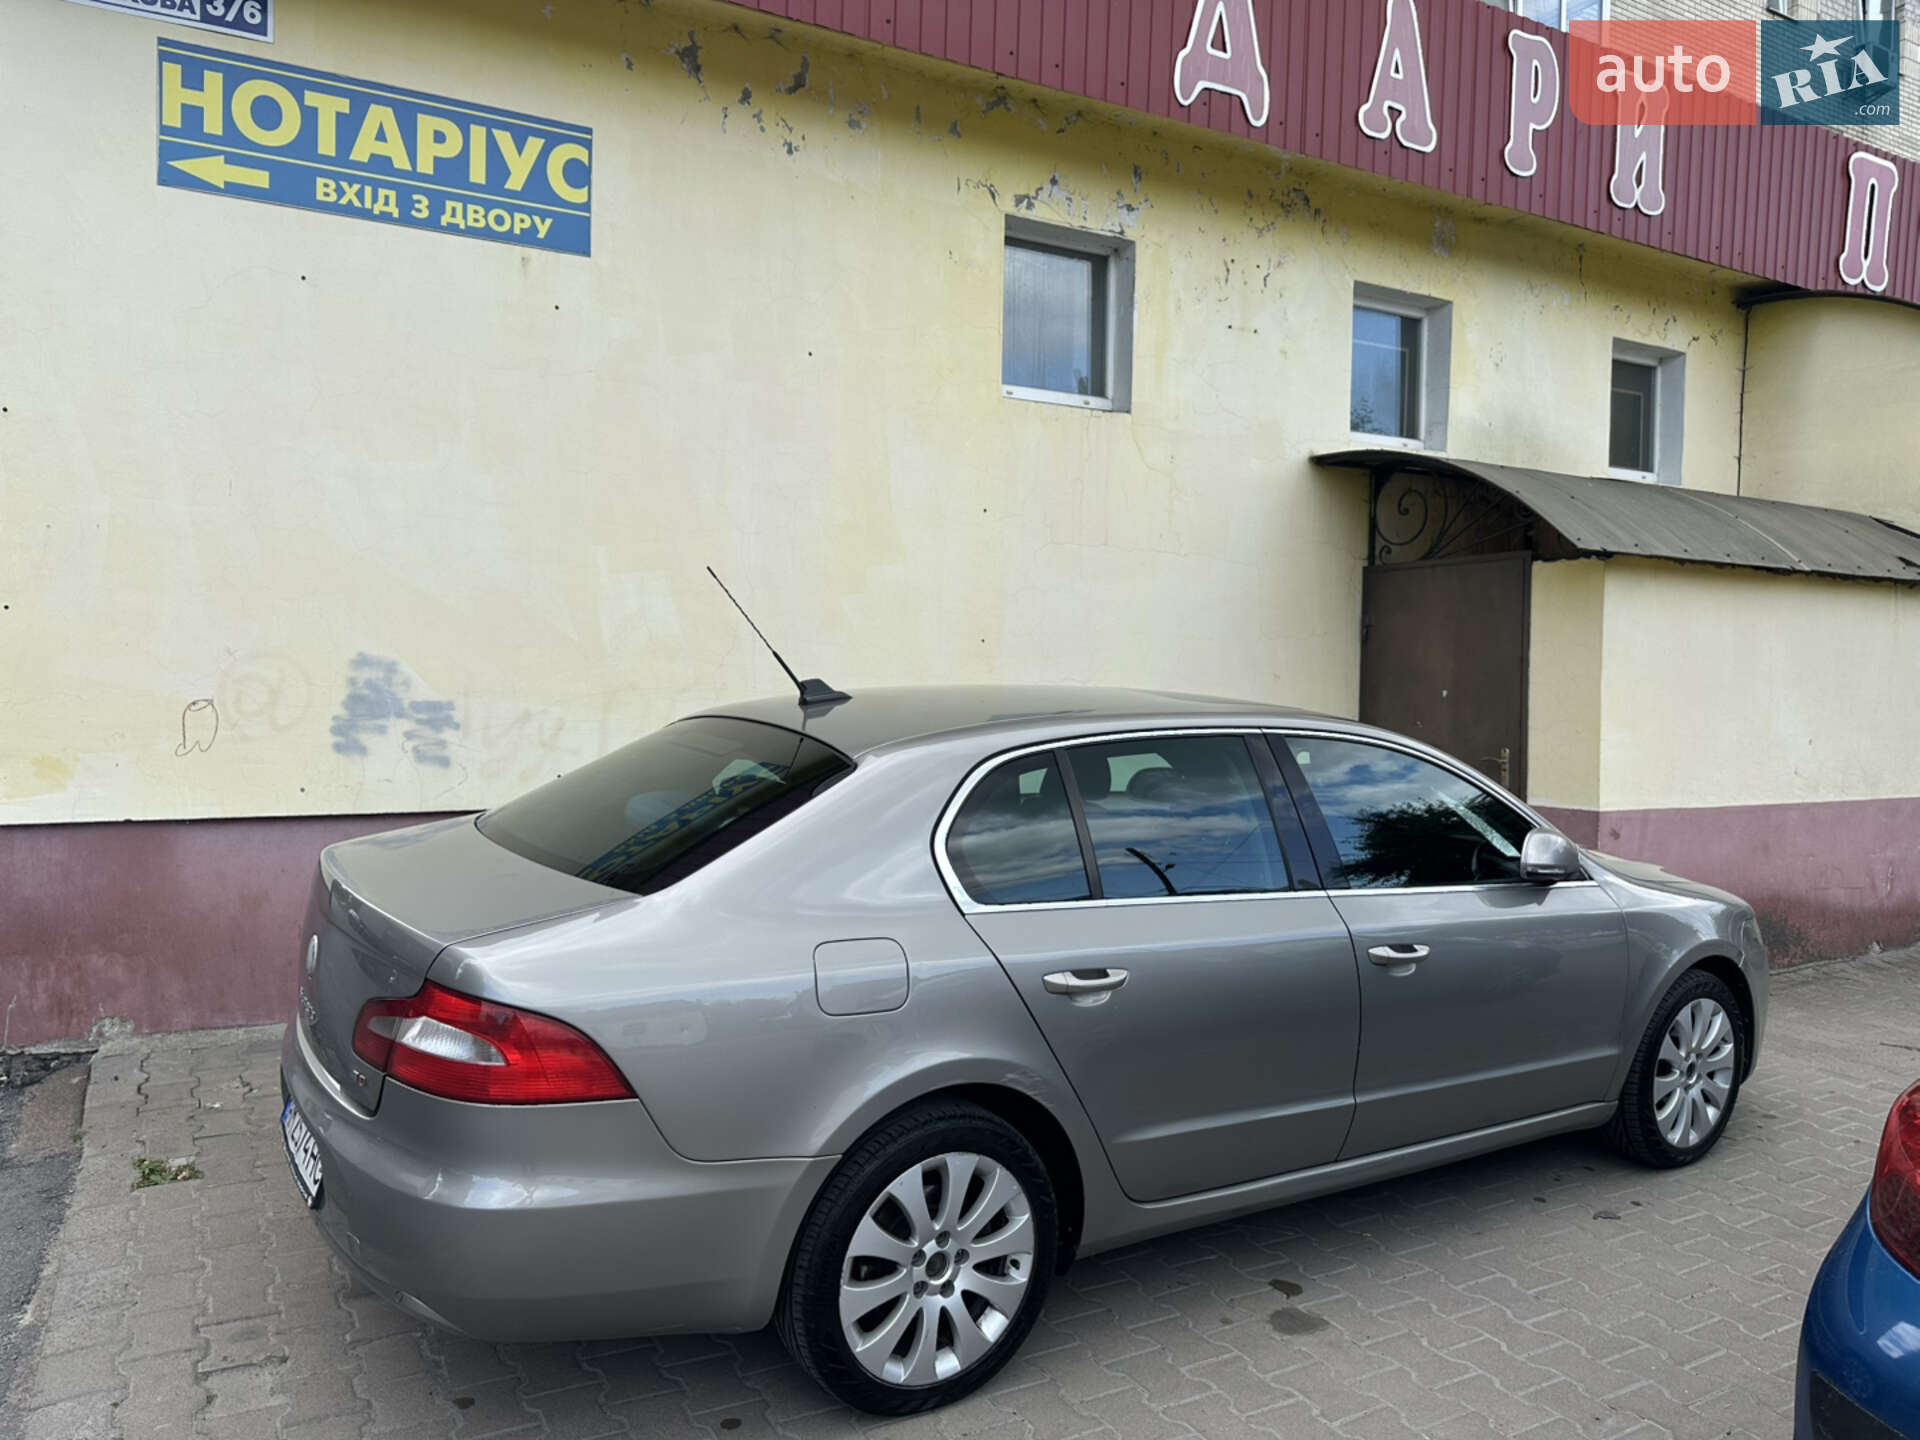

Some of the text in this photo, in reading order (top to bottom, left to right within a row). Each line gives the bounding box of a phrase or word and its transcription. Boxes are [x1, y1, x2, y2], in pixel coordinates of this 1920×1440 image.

[206, 0, 262, 25] 3/6
[161, 61, 590, 204] НОТАРІУС
[315, 176, 399, 218] ВХІД
[440, 199, 553, 239] ДВОРУ
